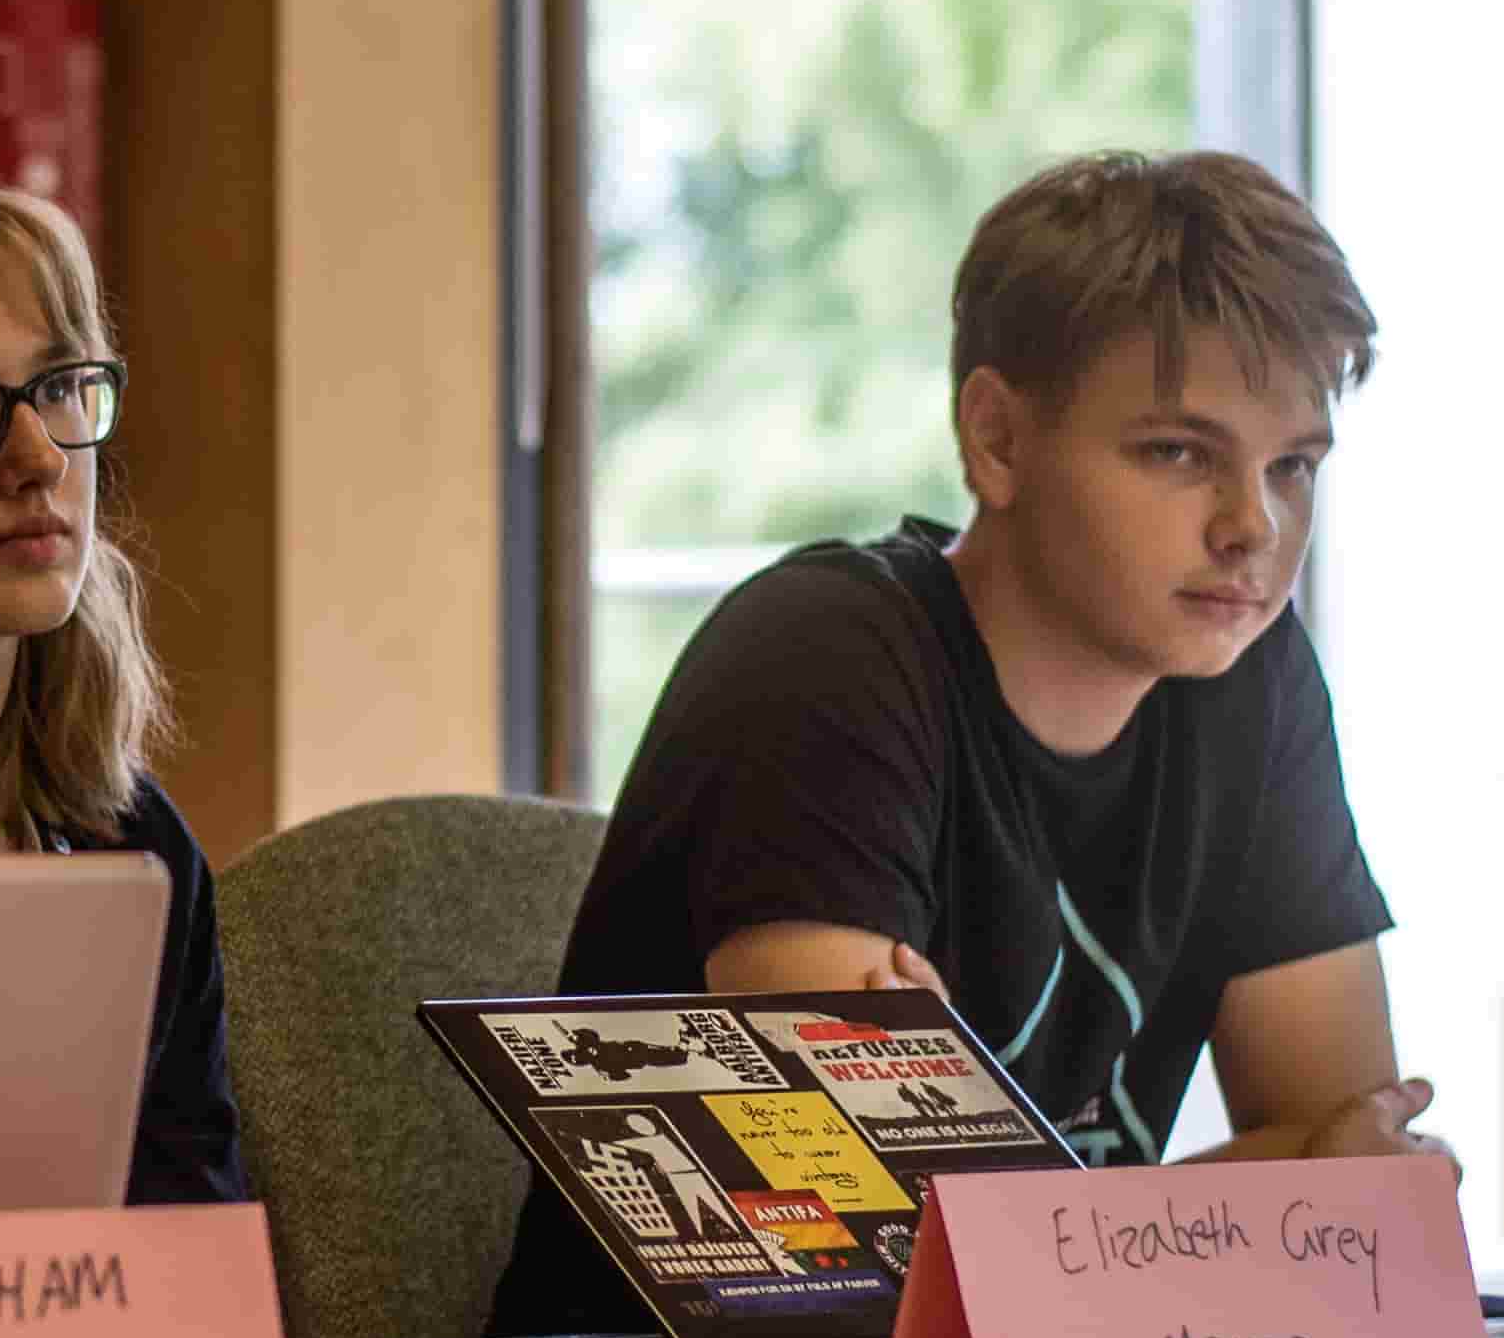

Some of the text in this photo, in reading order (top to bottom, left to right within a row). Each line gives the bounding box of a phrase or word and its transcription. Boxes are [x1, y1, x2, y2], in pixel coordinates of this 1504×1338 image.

[494, 1027, 558, 1088] NAZIFRI
[526, 1037, 574, 1077] ZONE
[689, 1013, 755, 1082] AALBORG
[728, 1033, 783, 1084] ANTIFA
[820, 1058, 974, 1081] WELCOME
[822, 1117, 848, 1135] old
[875, 1124, 1024, 1140] NO ONE IS ILLEGAL
[754, 1205, 822, 1222] ANTIFA
[1053, 1199, 1381, 1312] Elizabeth Grey
